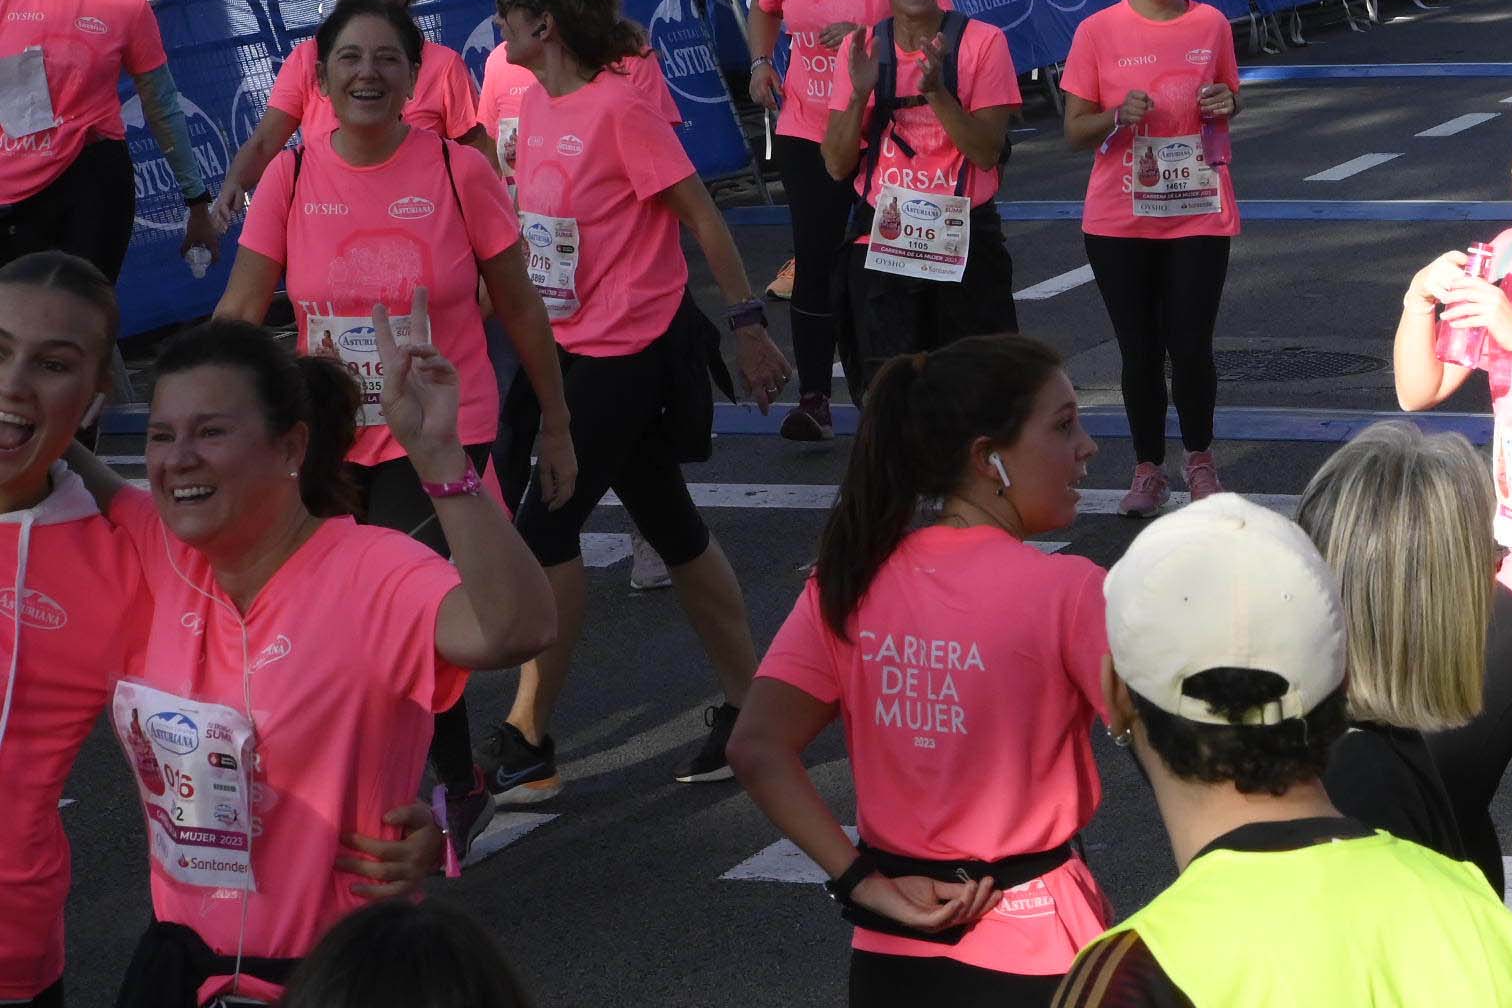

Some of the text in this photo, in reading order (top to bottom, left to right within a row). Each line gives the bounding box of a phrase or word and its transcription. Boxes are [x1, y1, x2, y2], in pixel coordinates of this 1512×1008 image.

[8, 12, 44, 22] OYSHO
[1163, 167, 1190, 180] 016
[1166, 182, 1187, 190] 14617
[305, 203, 349, 215] OYSHO
[904, 224, 935, 240] 016
[909, 241, 928, 250] 1105
[882, 666, 959, 702] DE LA
[875, 698, 968, 735] MUJER
[913, 736, 936, 749] 2023
[180, 831, 243, 846] MUJER 2023
